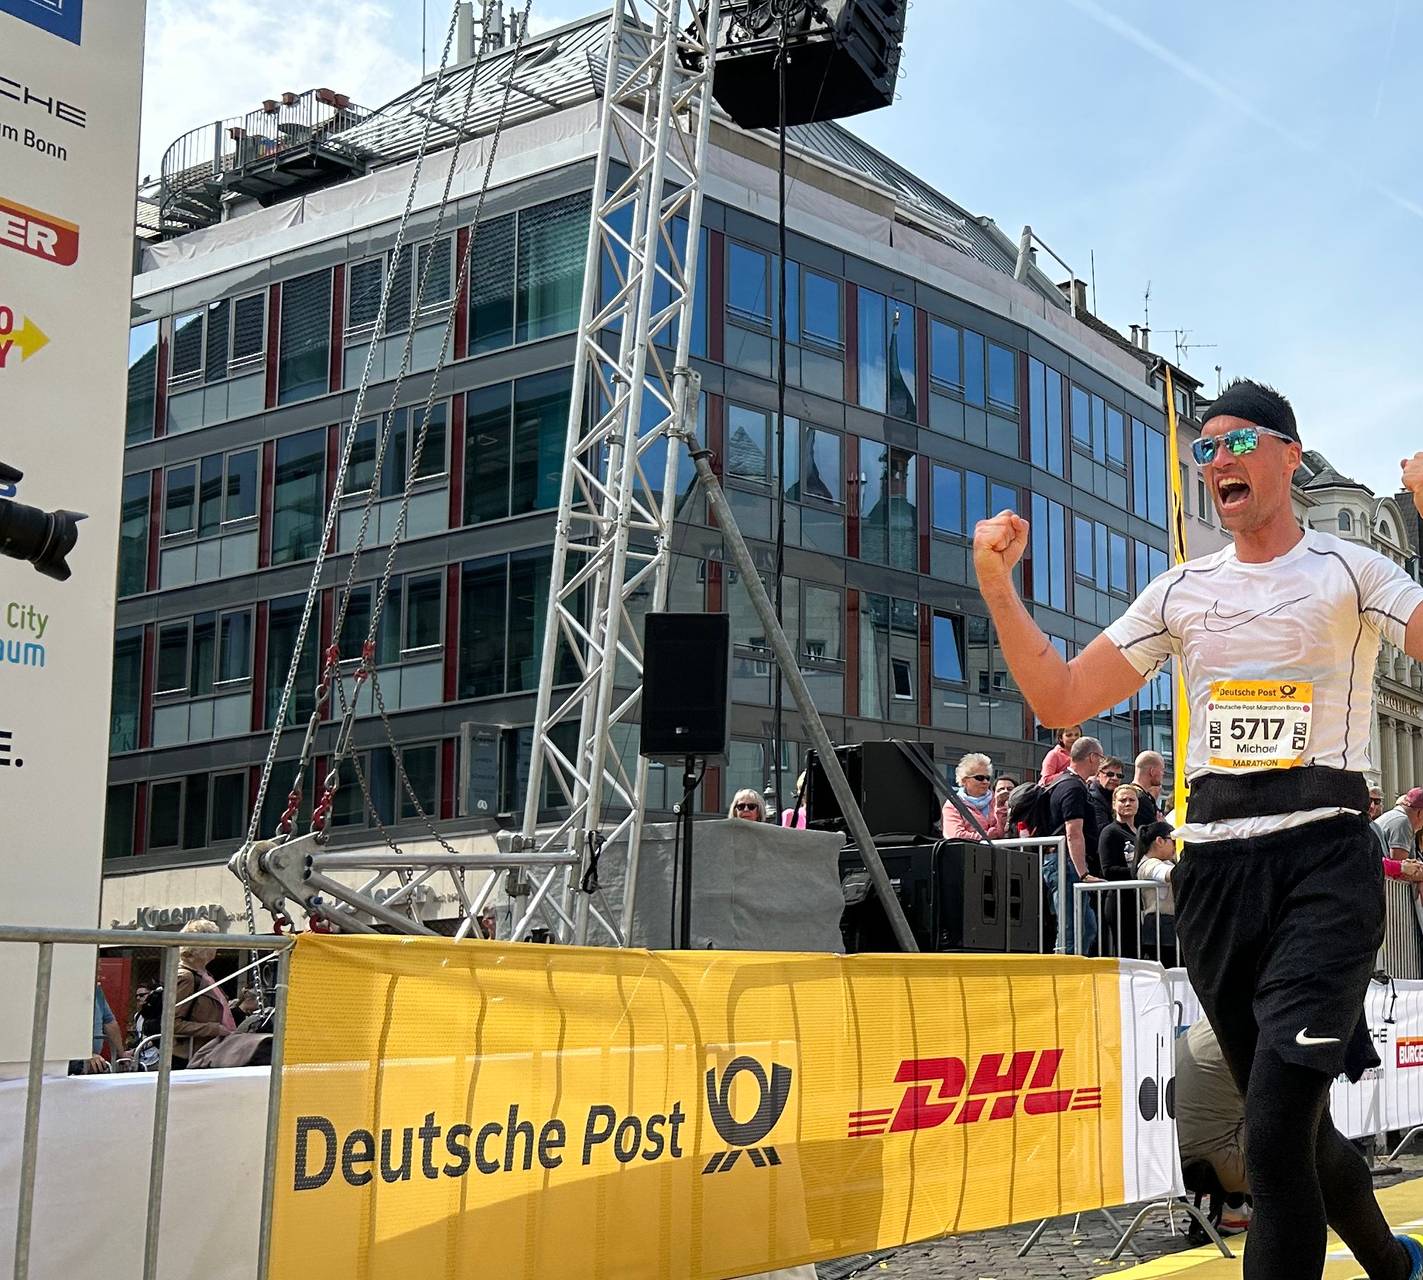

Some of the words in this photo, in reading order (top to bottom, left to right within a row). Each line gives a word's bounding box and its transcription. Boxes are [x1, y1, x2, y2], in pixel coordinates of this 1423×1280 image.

[24, 127, 68, 161] Bonn
[7, 601, 49, 640] City
[1219, 688, 1256, 697] Deutsche
[1257, 688, 1277, 697] Post
[1230, 718, 1285, 740] 5717
[1236, 743, 1278, 753] Michael
[1232, 759, 1278, 767] MARATHON
[886, 1048, 1076, 1134] DHL
[293, 1103, 567, 1191] Deutsche
[581, 1100, 686, 1166] Post
